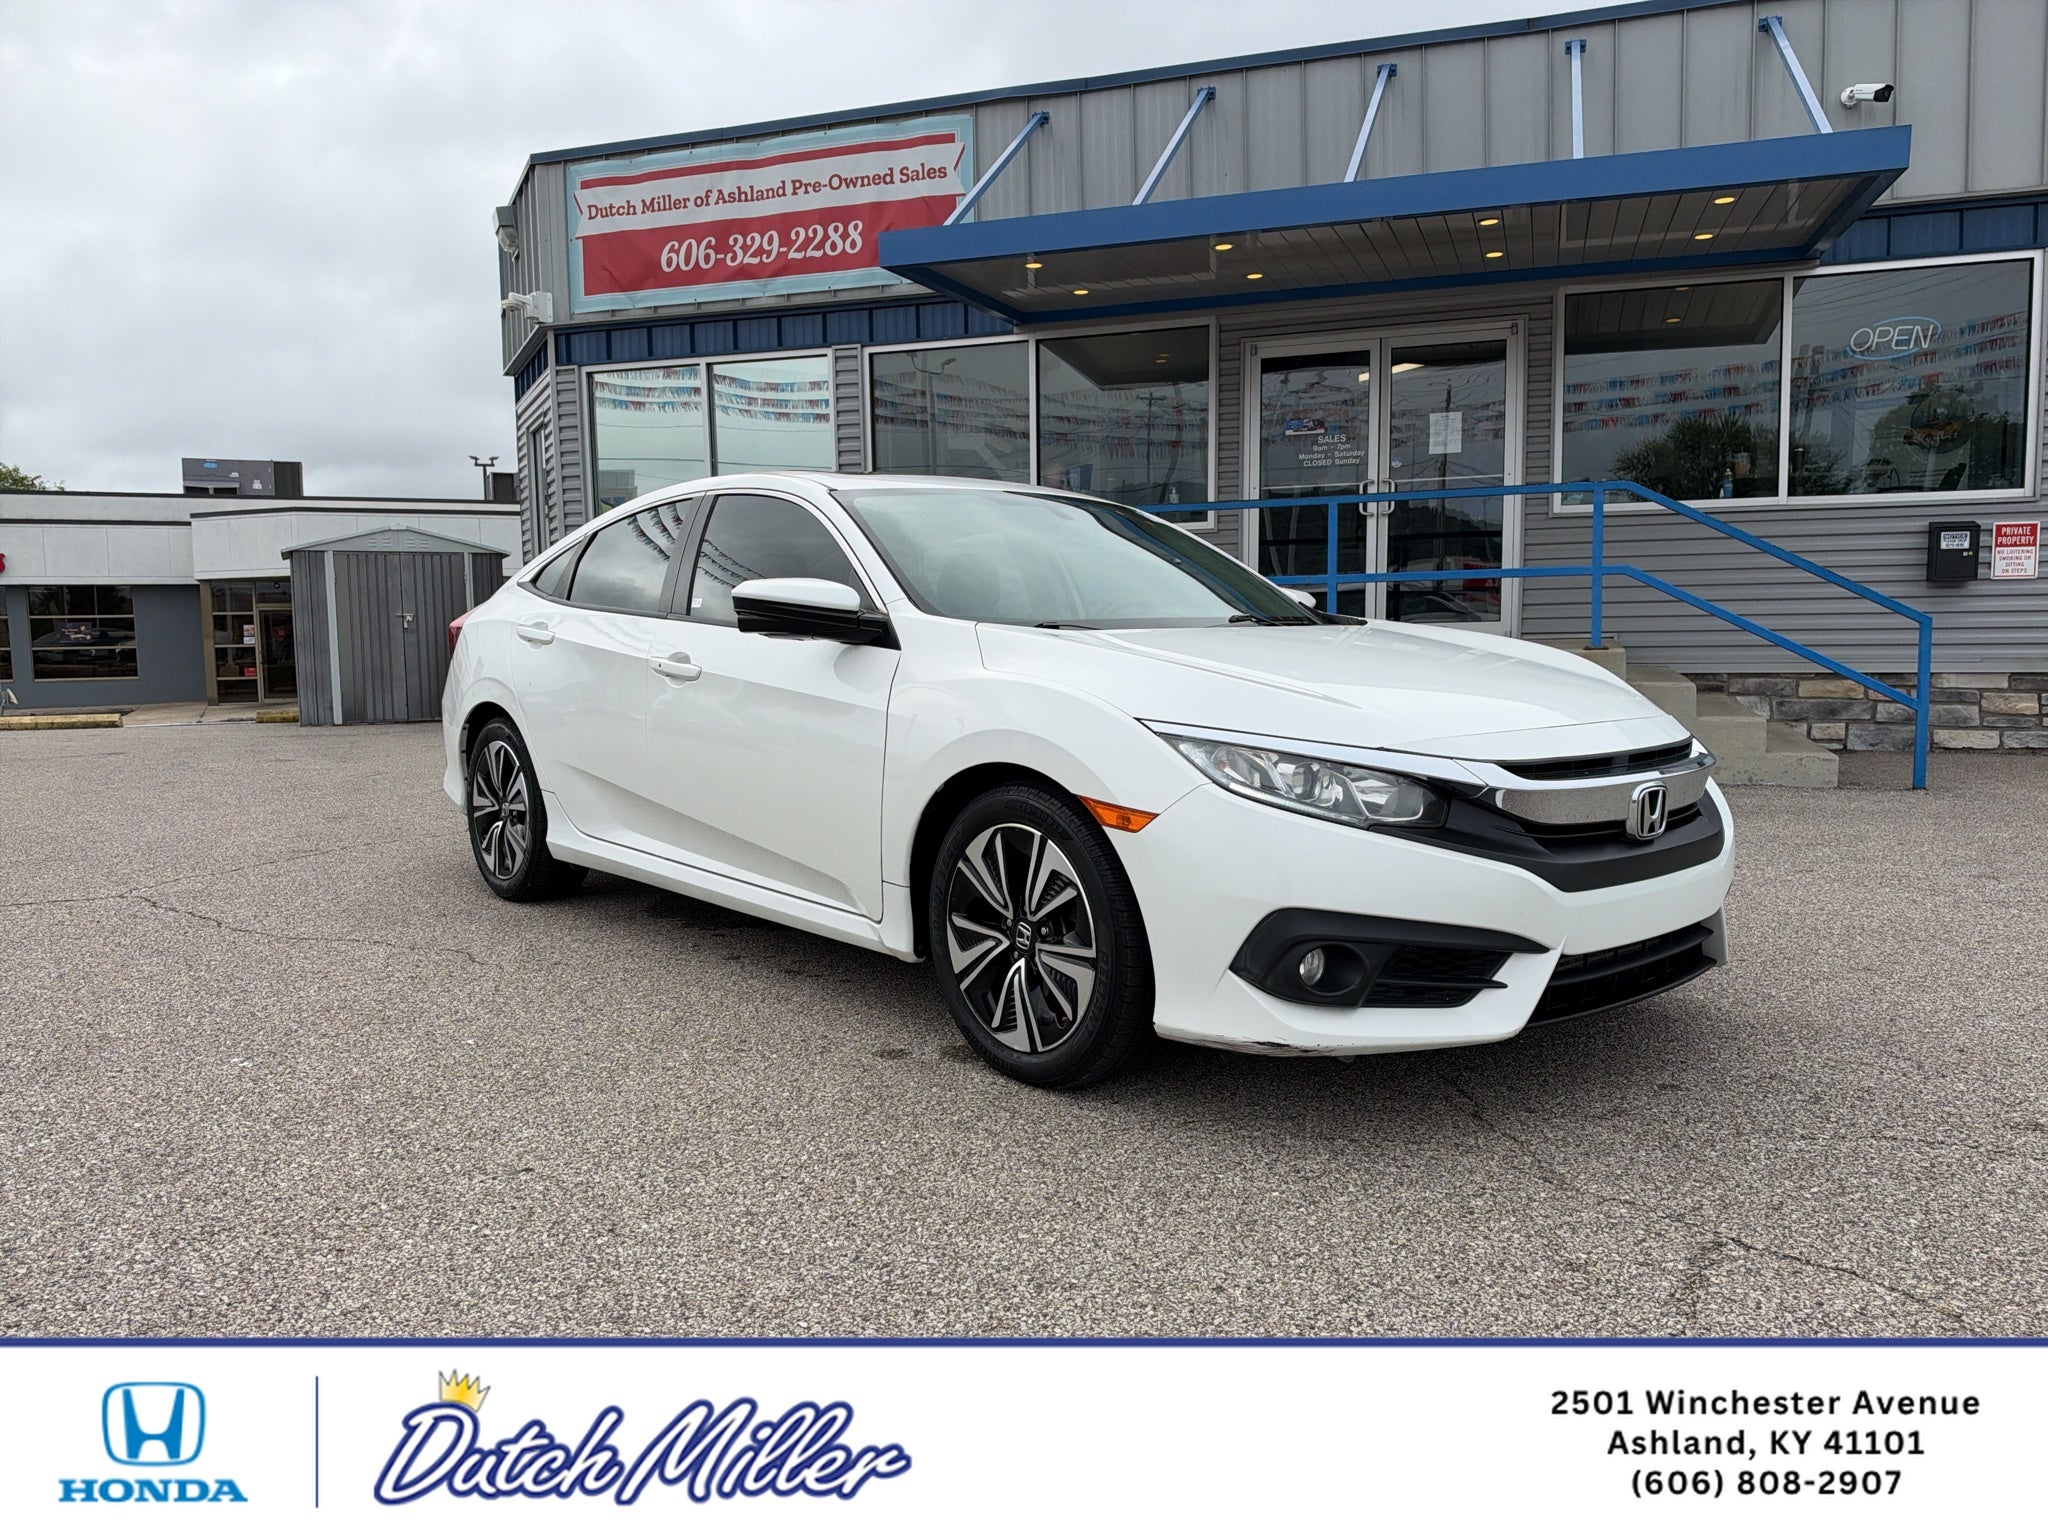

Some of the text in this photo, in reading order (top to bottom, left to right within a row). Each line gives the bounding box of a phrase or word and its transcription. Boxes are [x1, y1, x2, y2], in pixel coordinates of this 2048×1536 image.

[587, 162, 948, 221] Dutch Miller of Ashland Pre-Owned Sales
[660, 219, 864, 273] 606-329-2288
[1850, 324, 1934, 352] OPEN
[1317, 434, 1347, 444] SALES
[1312, 443, 1328, 452] 9am
[1337, 443, 1352, 452] 7pm
[1298, 452, 1325, 462] Monday
[1334, 449, 1366, 459] Saturday
[1303, 456, 1361, 467] CLOSED Sunday
[2001, 526, 2032, 535] PRIVATE
[1997, 535, 2035, 545] PROPERTY
